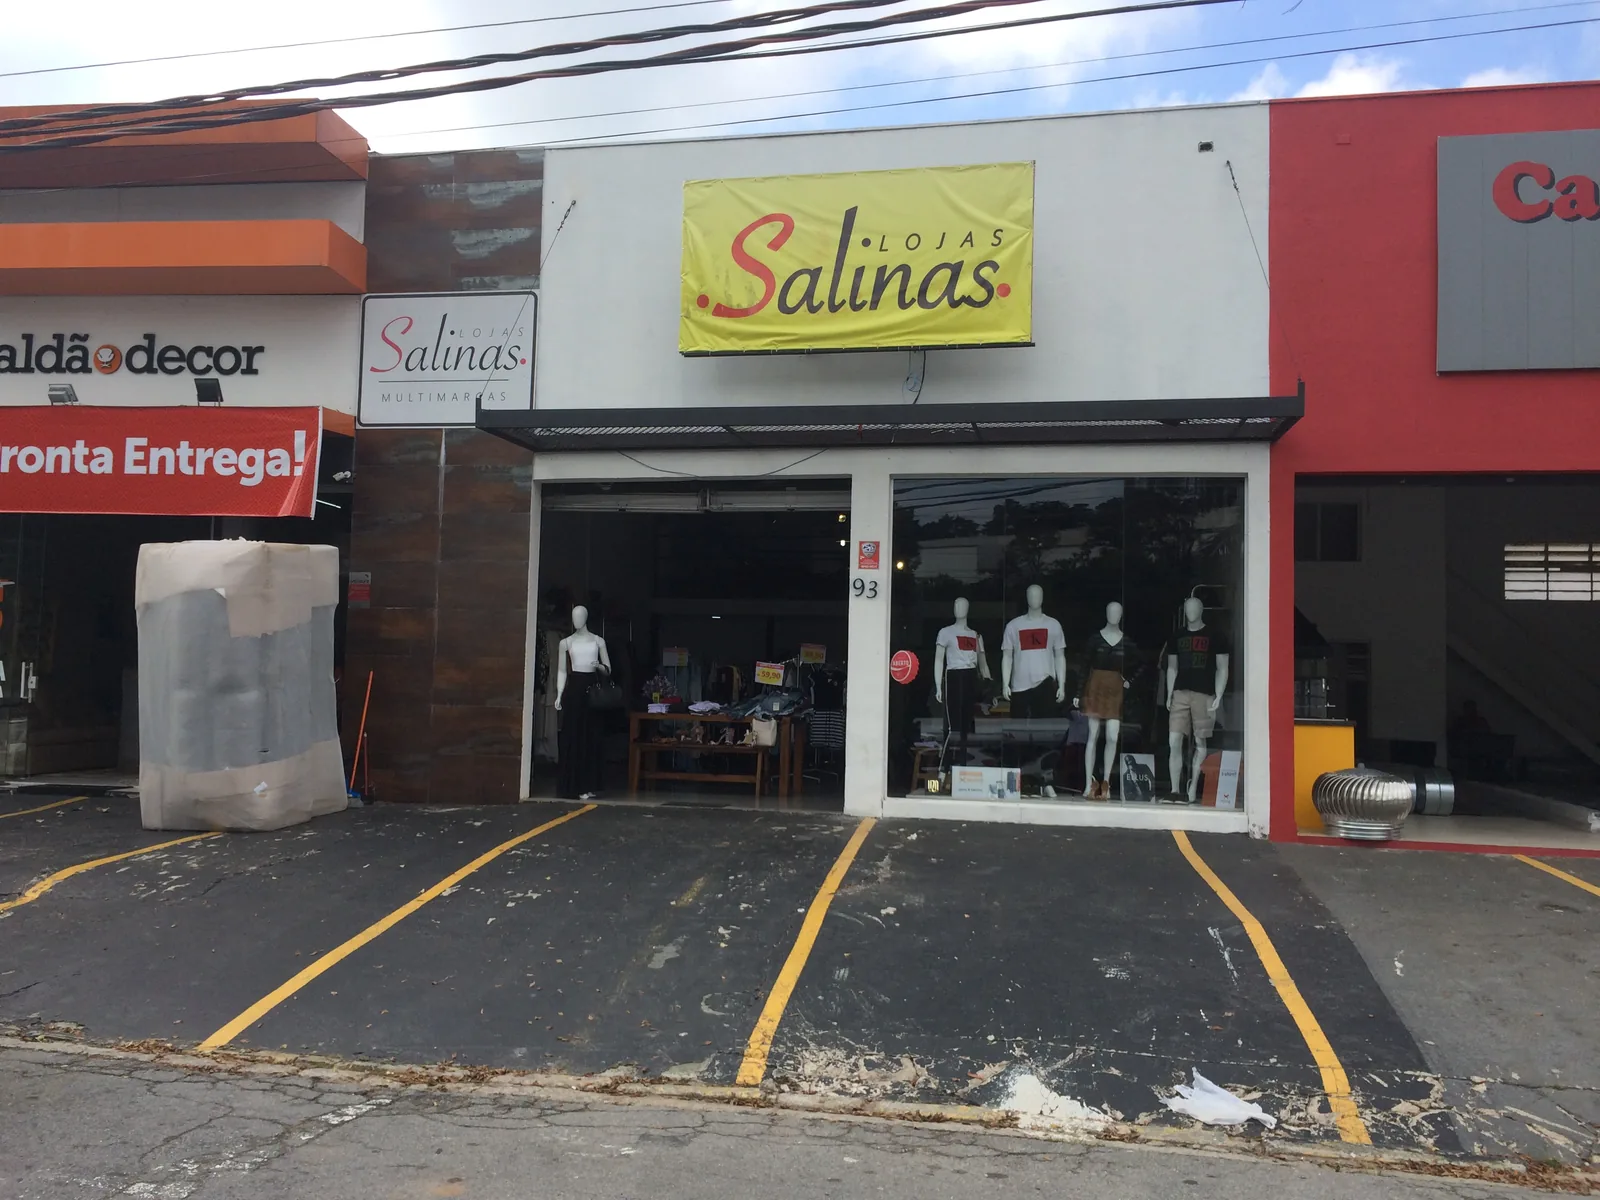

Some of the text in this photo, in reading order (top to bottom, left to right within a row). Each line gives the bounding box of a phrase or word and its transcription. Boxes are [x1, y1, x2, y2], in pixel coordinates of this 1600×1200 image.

[878, 228, 1004, 252] LOJAS
[459, 326, 525, 338] LOJAS
[125, 333, 265, 375] decor
[0, 430, 306, 487] ronta Entrega!
[852, 577, 878, 599] 93
[760, 670, 781, 681] 59,90
